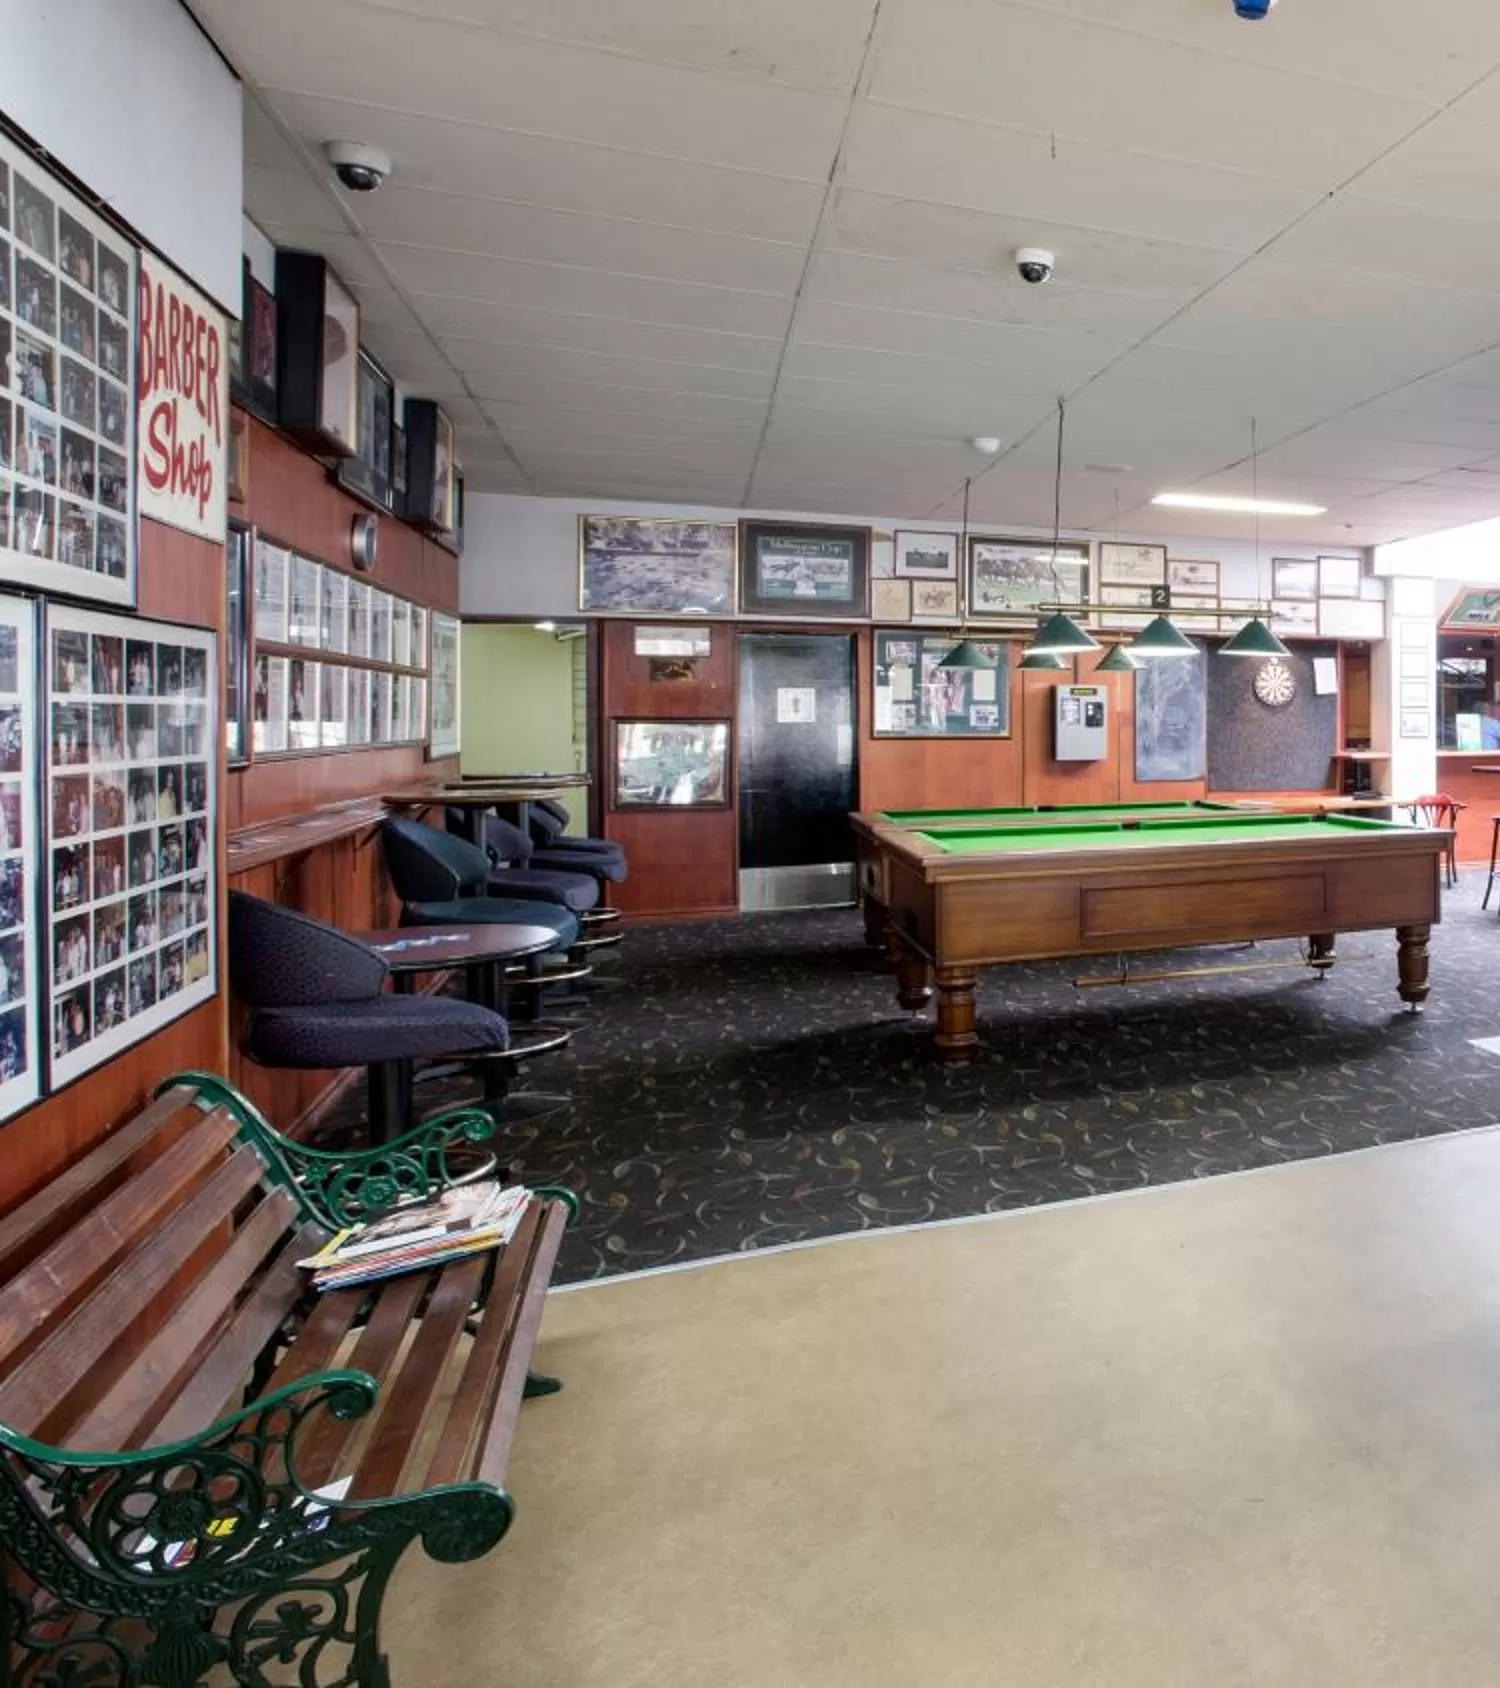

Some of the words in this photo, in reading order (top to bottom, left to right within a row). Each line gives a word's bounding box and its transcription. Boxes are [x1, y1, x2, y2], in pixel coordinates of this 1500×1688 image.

[139, 267, 221, 448] BARBER
[143, 398, 213, 520] Shop
[1155, 590, 1166, 603] 2
